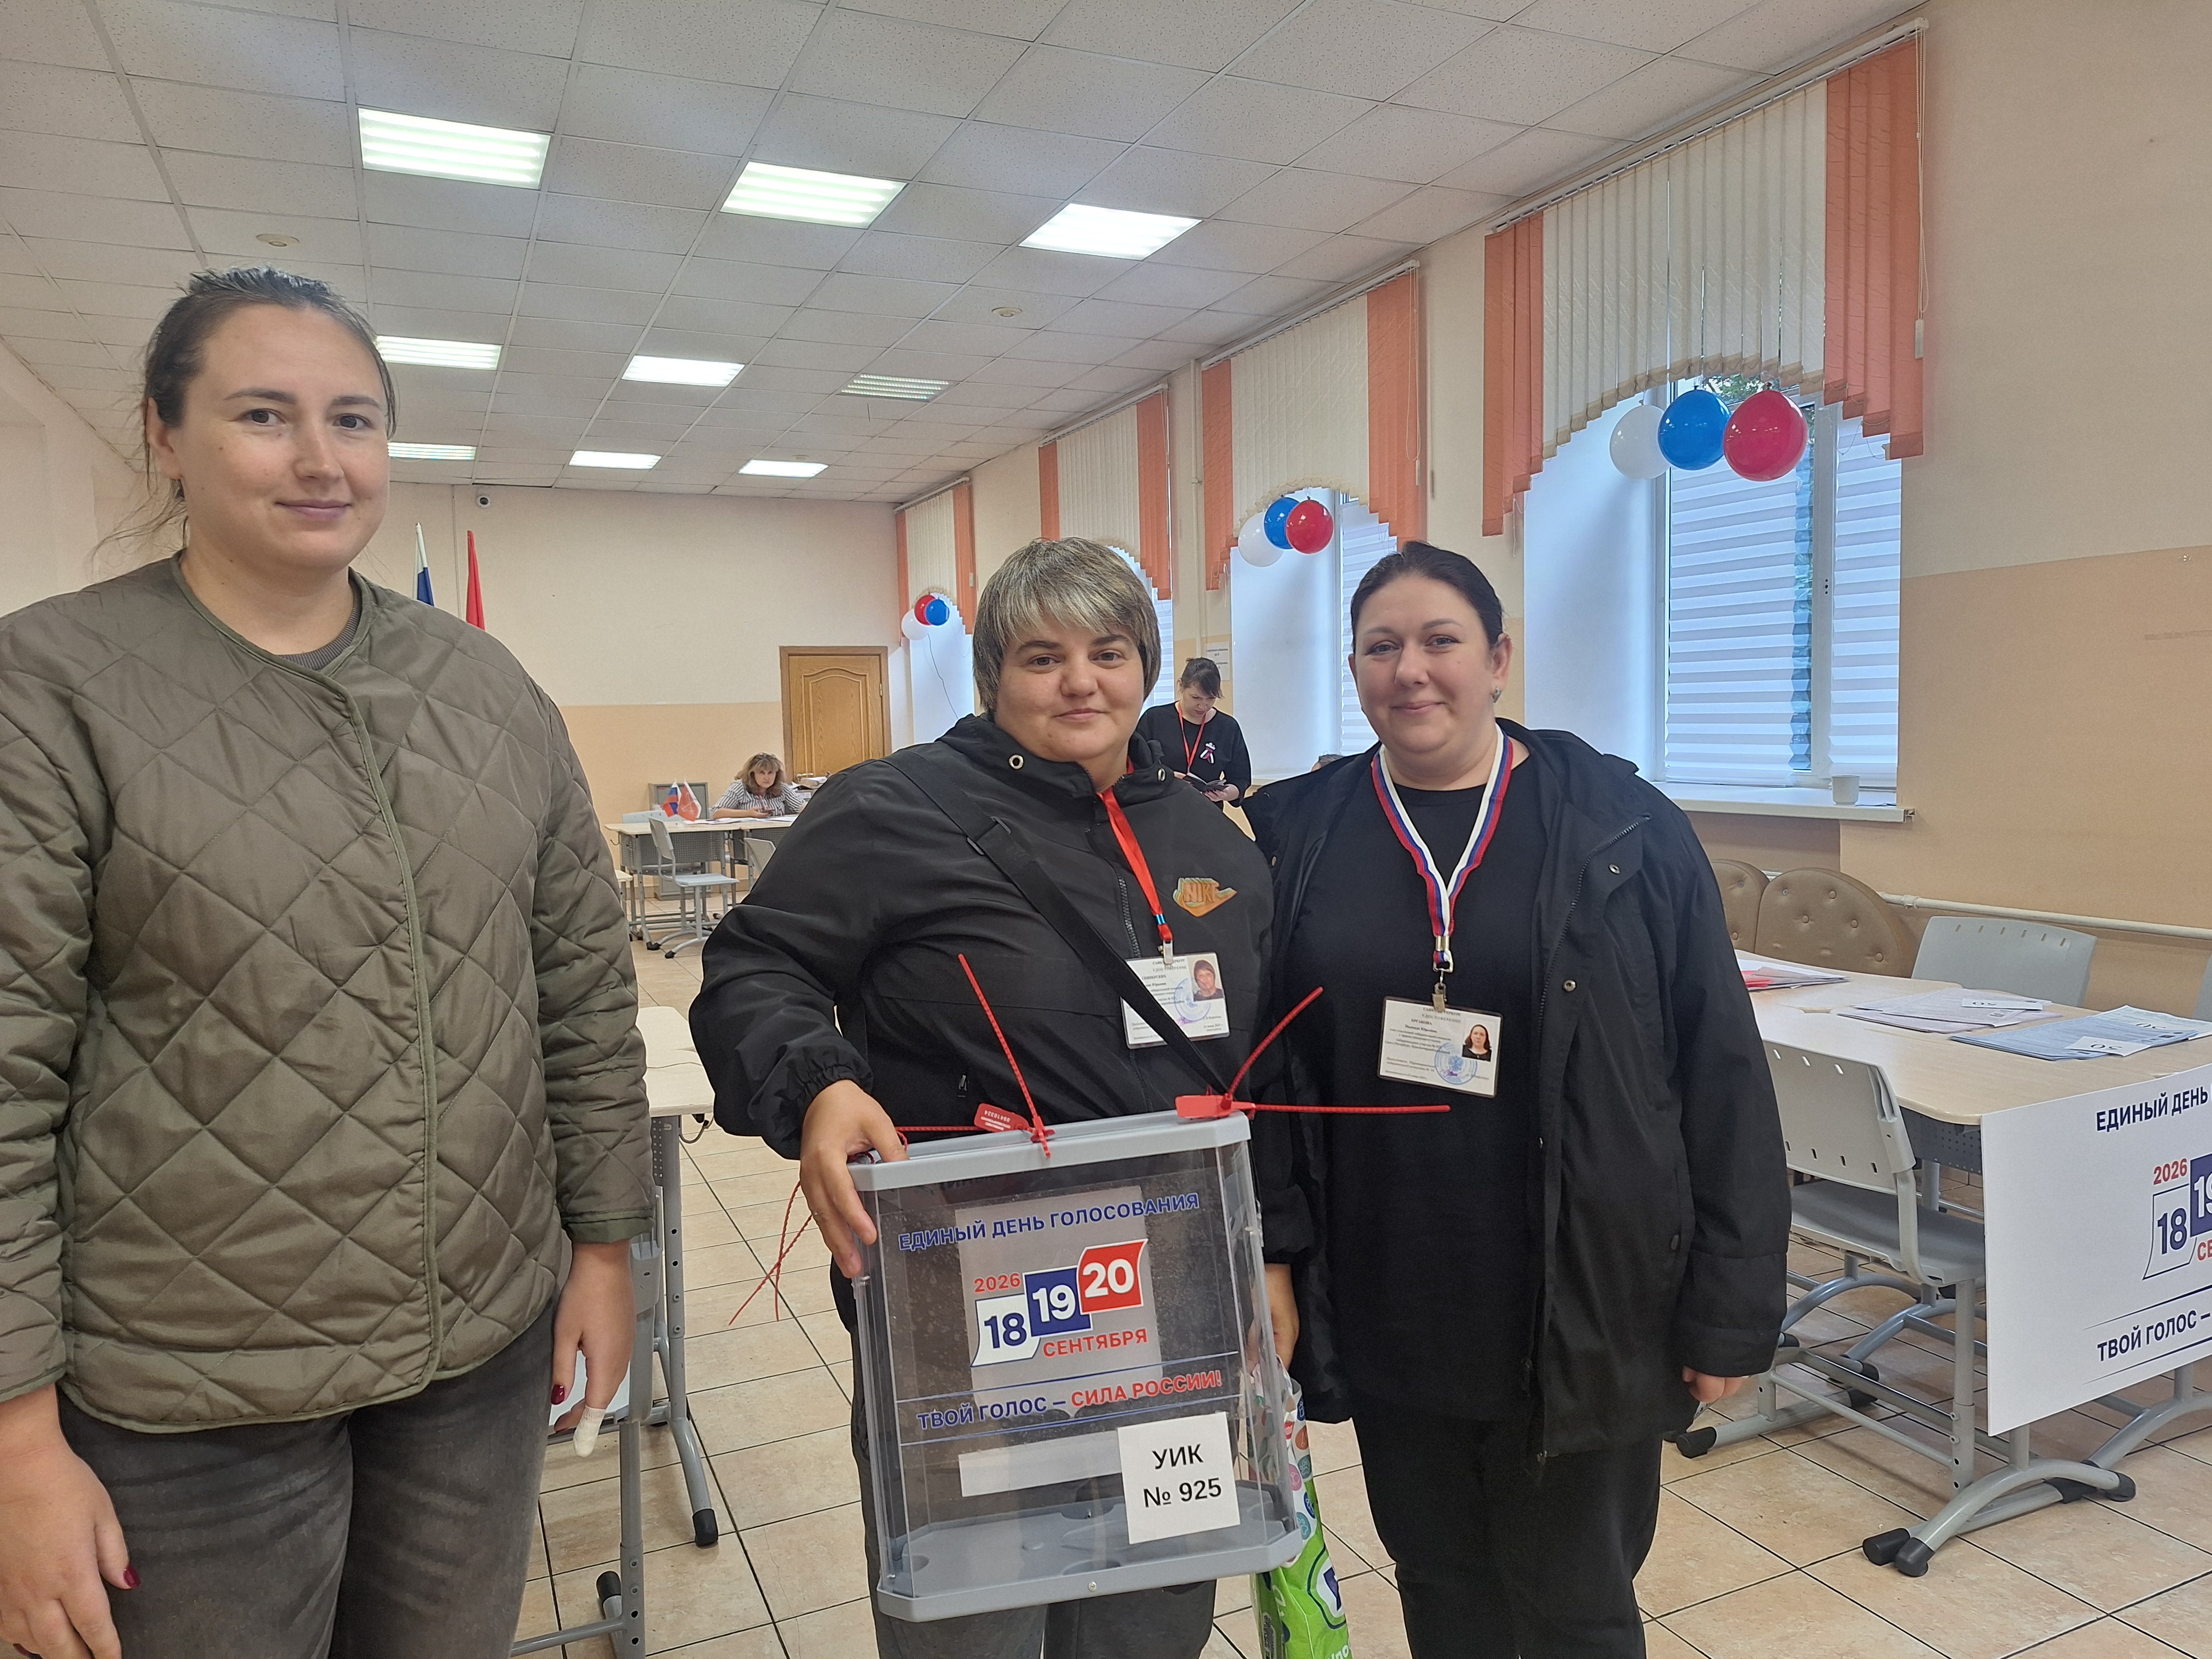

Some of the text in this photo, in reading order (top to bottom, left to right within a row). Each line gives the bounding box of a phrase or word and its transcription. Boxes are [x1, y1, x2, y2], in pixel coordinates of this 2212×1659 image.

[1179, 878, 1219, 903] NIKE
[2097, 1086, 2208, 1133] ЕДИНЫЙ ДЕНЬ
[2153, 1158, 2188, 1185] 2026
[898, 1193, 1200, 1251] ЕДИНЫЙ ДЕНЬ ГОЛОСОВАНИЯ
[2157, 1208, 2187, 1255] 18
[974, 1273, 1021, 1292] 2026
[984, 1258, 1134, 1349] 18 19 20
[1043, 1328, 1148, 1357] СЕНТЯБРЯ
[2097, 1325, 2141, 1361] ТВОЙ
[2146, 1310, 2197, 1345] ГОЛОС
[917, 1403, 974, 1429] ТВОЙ
[979, 1397, 1047, 1421] ГОЛОС
[1071, 1385, 1128, 1407] СИЛА
[1131, 1369, 1223, 1398] РОССИИ!
[1152, 1443, 1204, 1470] УИК
[1143, 1477, 1221, 1508] № 925
